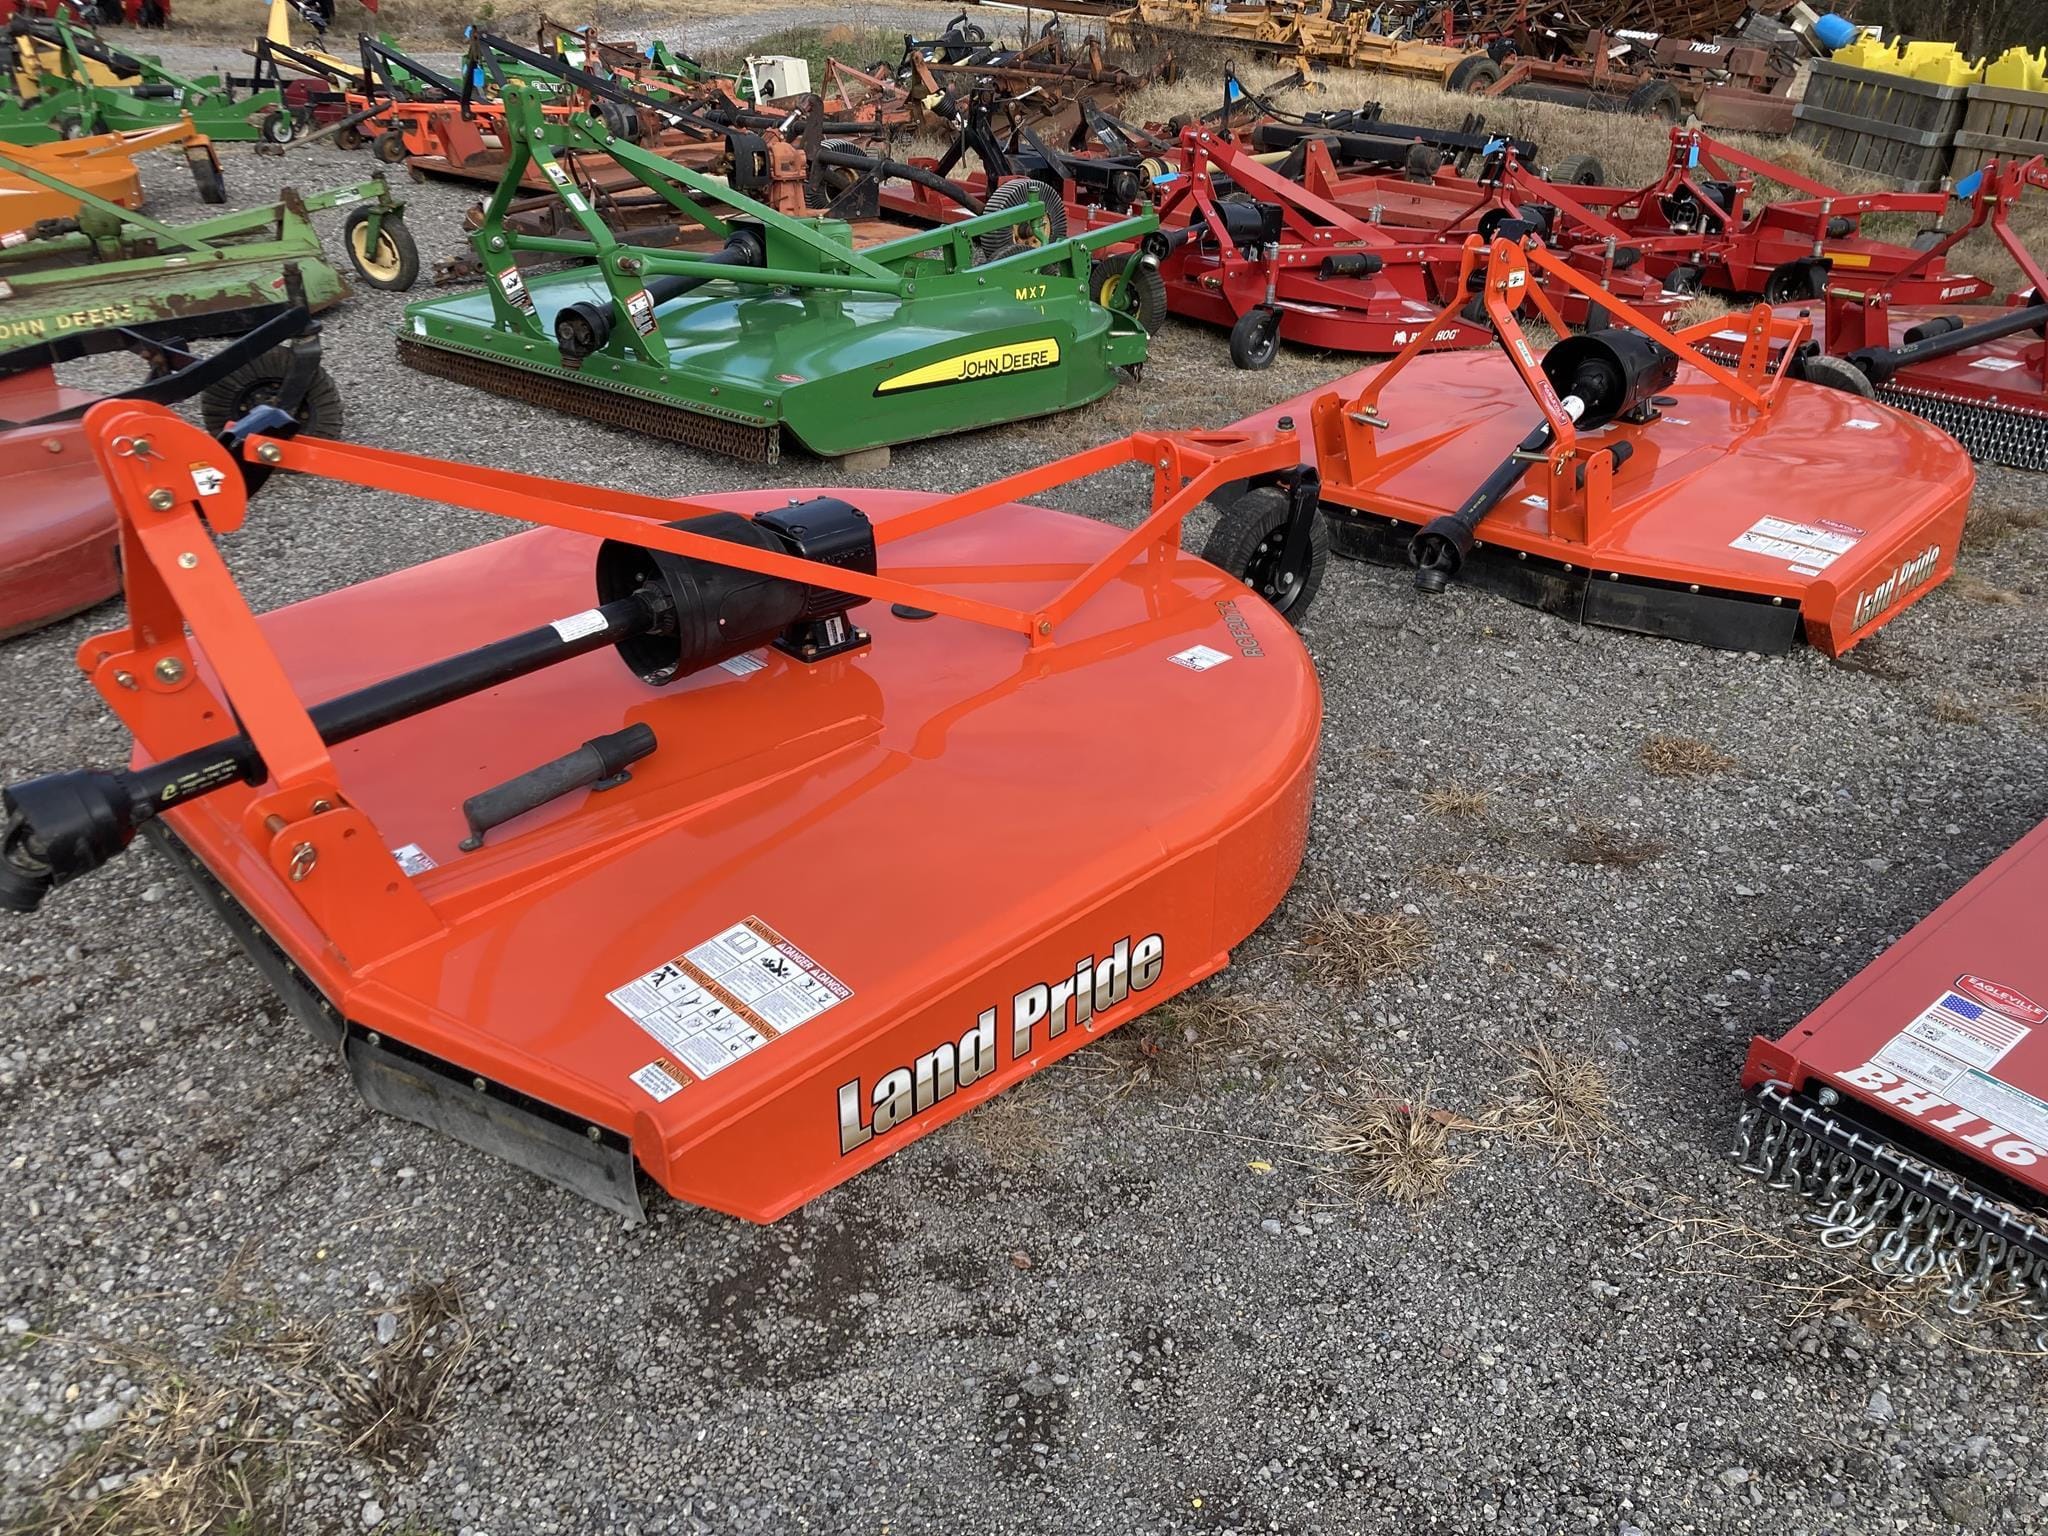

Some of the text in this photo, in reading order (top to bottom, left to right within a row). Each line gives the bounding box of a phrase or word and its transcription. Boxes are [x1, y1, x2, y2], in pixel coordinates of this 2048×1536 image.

[1688, 42, 1720, 54] TW120
[56, 304, 133, 329] DEERE
[1435, 329, 1458, 341] HOG
[957, 350, 1048, 379] JOHN DEERE
[1851, 543, 1940, 635] Land Pride
[1215, 600, 1266, 658] RCF2072
[782, 946, 813, 972] DANGER
[681, 961, 709, 986] WARNING
[817, 971, 849, 998] DANGER
[712, 985, 741, 1010] WARNING
[1968, 976, 2043, 1015] EAGLEVILLE
[745, 1012, 777, 1039] WARNING
[1925, 1014, 1948, 1028] MADE
[837, 933, 1164, 1157] Land Pride
[1919, 1043, 1955, 1064] WARNING
[1896, 1063, 1933, 1084] WARNING
[1833, 1061, 2048, 1165] BH116
